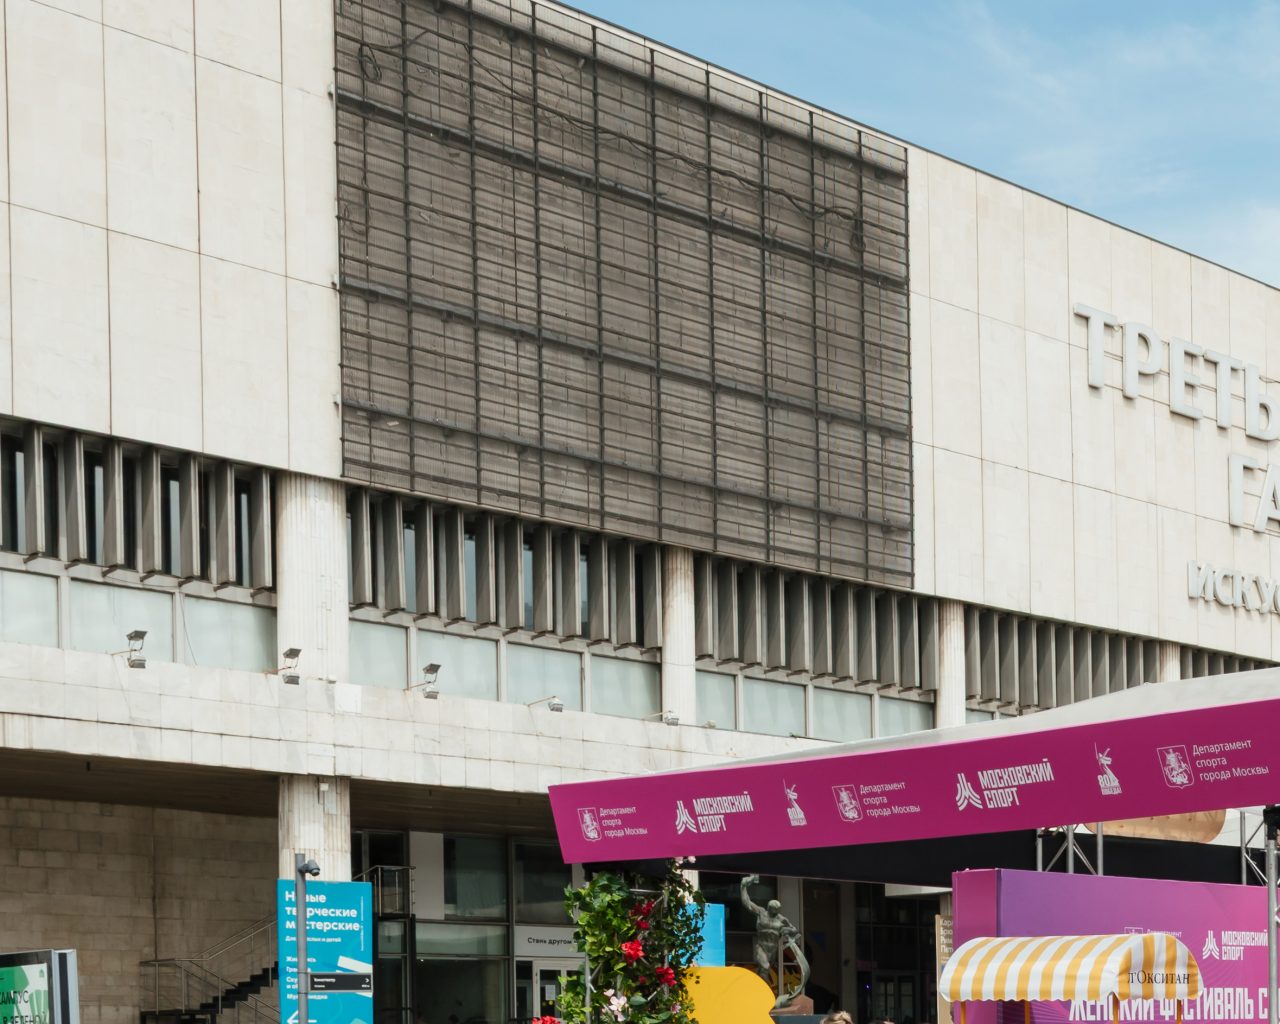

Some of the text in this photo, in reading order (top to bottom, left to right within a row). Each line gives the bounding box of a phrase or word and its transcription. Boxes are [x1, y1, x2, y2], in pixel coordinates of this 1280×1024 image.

[1192, 739, 1252, 756] Департамент
[1196, 757, 1227, 769] спорта
[978, 758, 1054, 789] МОСКОВСКИЙ
[1199, 764, 1269, 783] города Москвы
[860, 782, 906, 795] Департамент
[693, 791, 754, 815] МОСКОВСКИЙ
[863, 796, 888, 806] спорта
[983, 787, 1020, 809] СПОРТ
[866, 805, 920, 818] города Москвы
[697, 816, 727, 833] СПОРТ
[285, 890, 327, 903] Нвые
[285, 906, 358, 919] тврческие
[285, 920, 360, 932] мтерские
[1222, 929, 1268, 946] МОСКОВСКИЙ
[1222, 946, 1244, 960] СПОРТ
